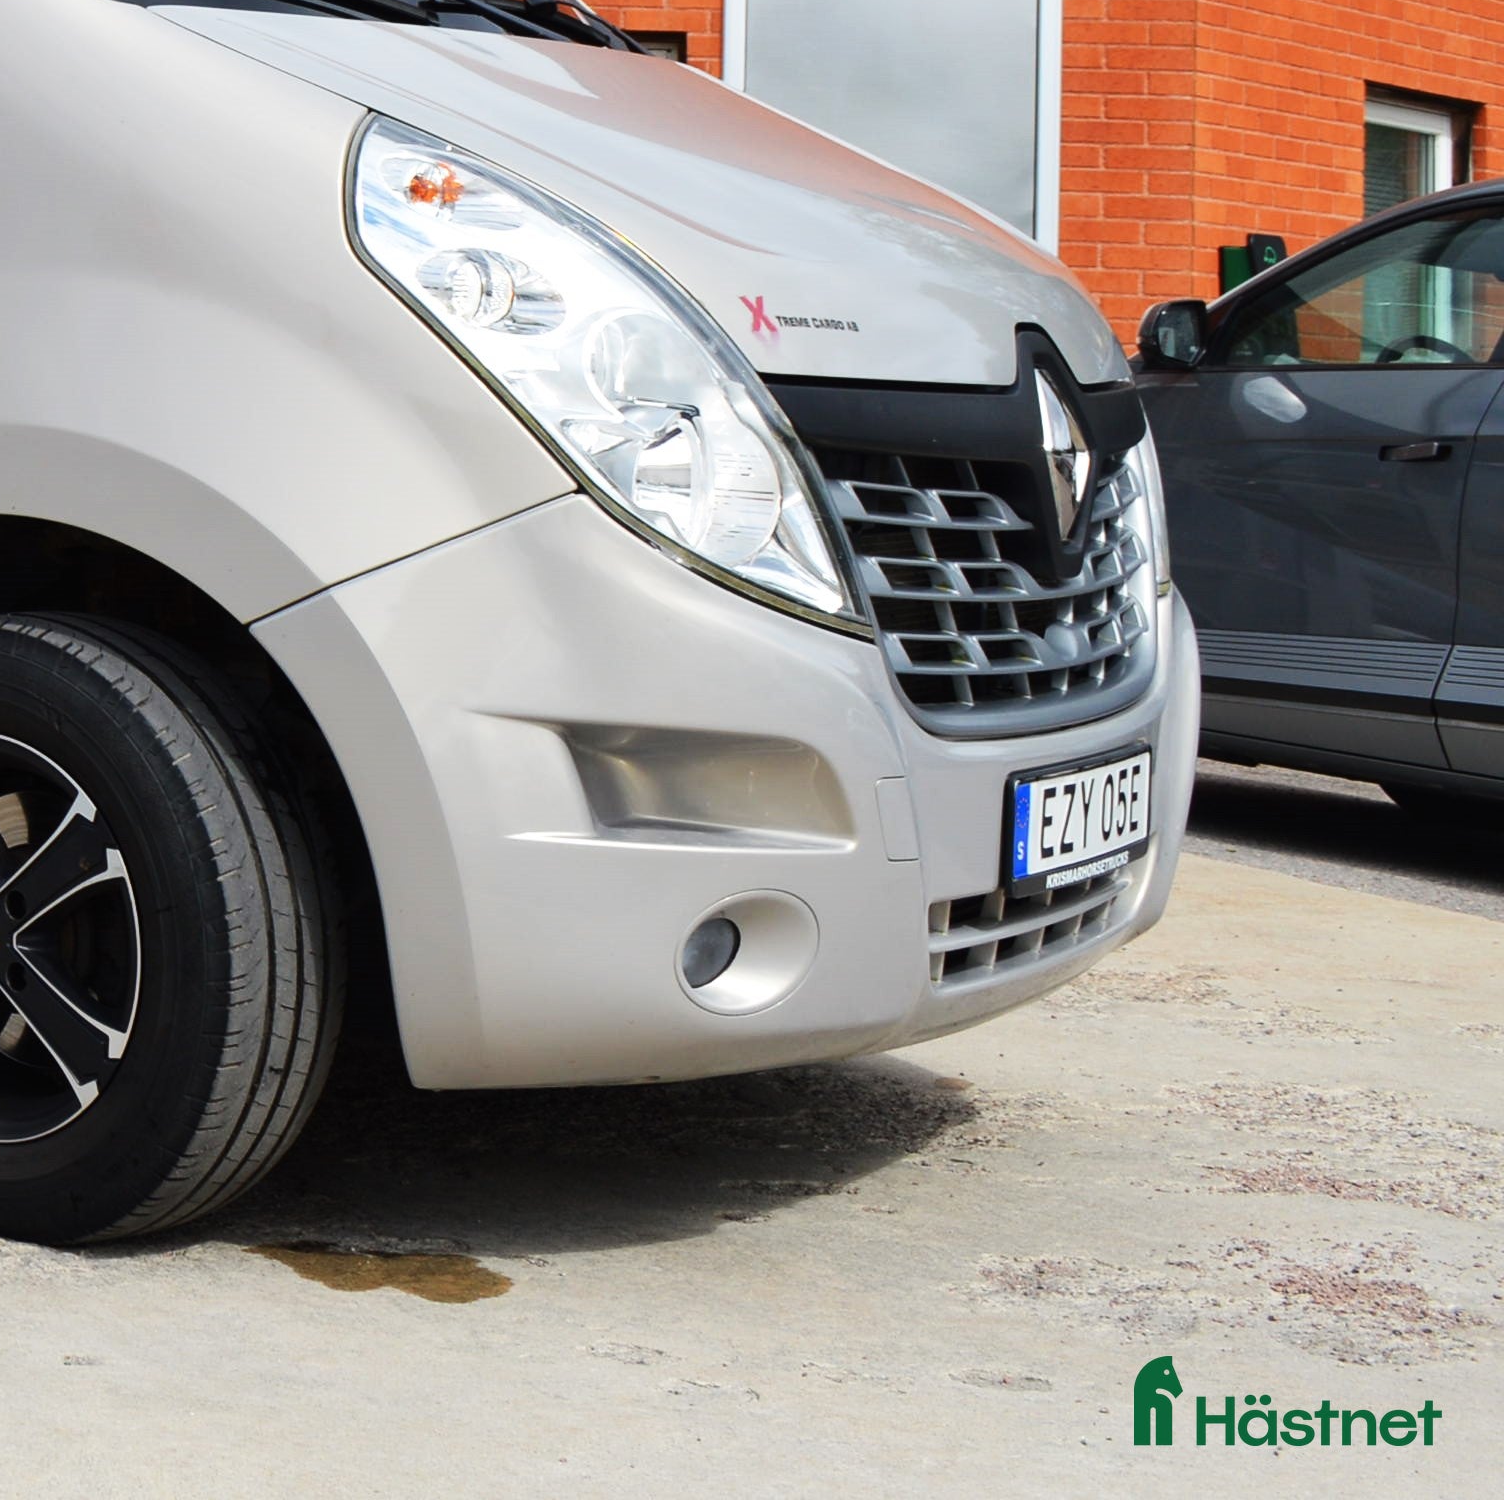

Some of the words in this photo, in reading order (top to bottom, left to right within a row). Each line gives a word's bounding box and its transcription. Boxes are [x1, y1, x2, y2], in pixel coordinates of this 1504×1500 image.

[811, 317, 846, 331] CARGO
[1041, 778, 1095, 859] EZY
[1017, 841, 1024, 860] S
